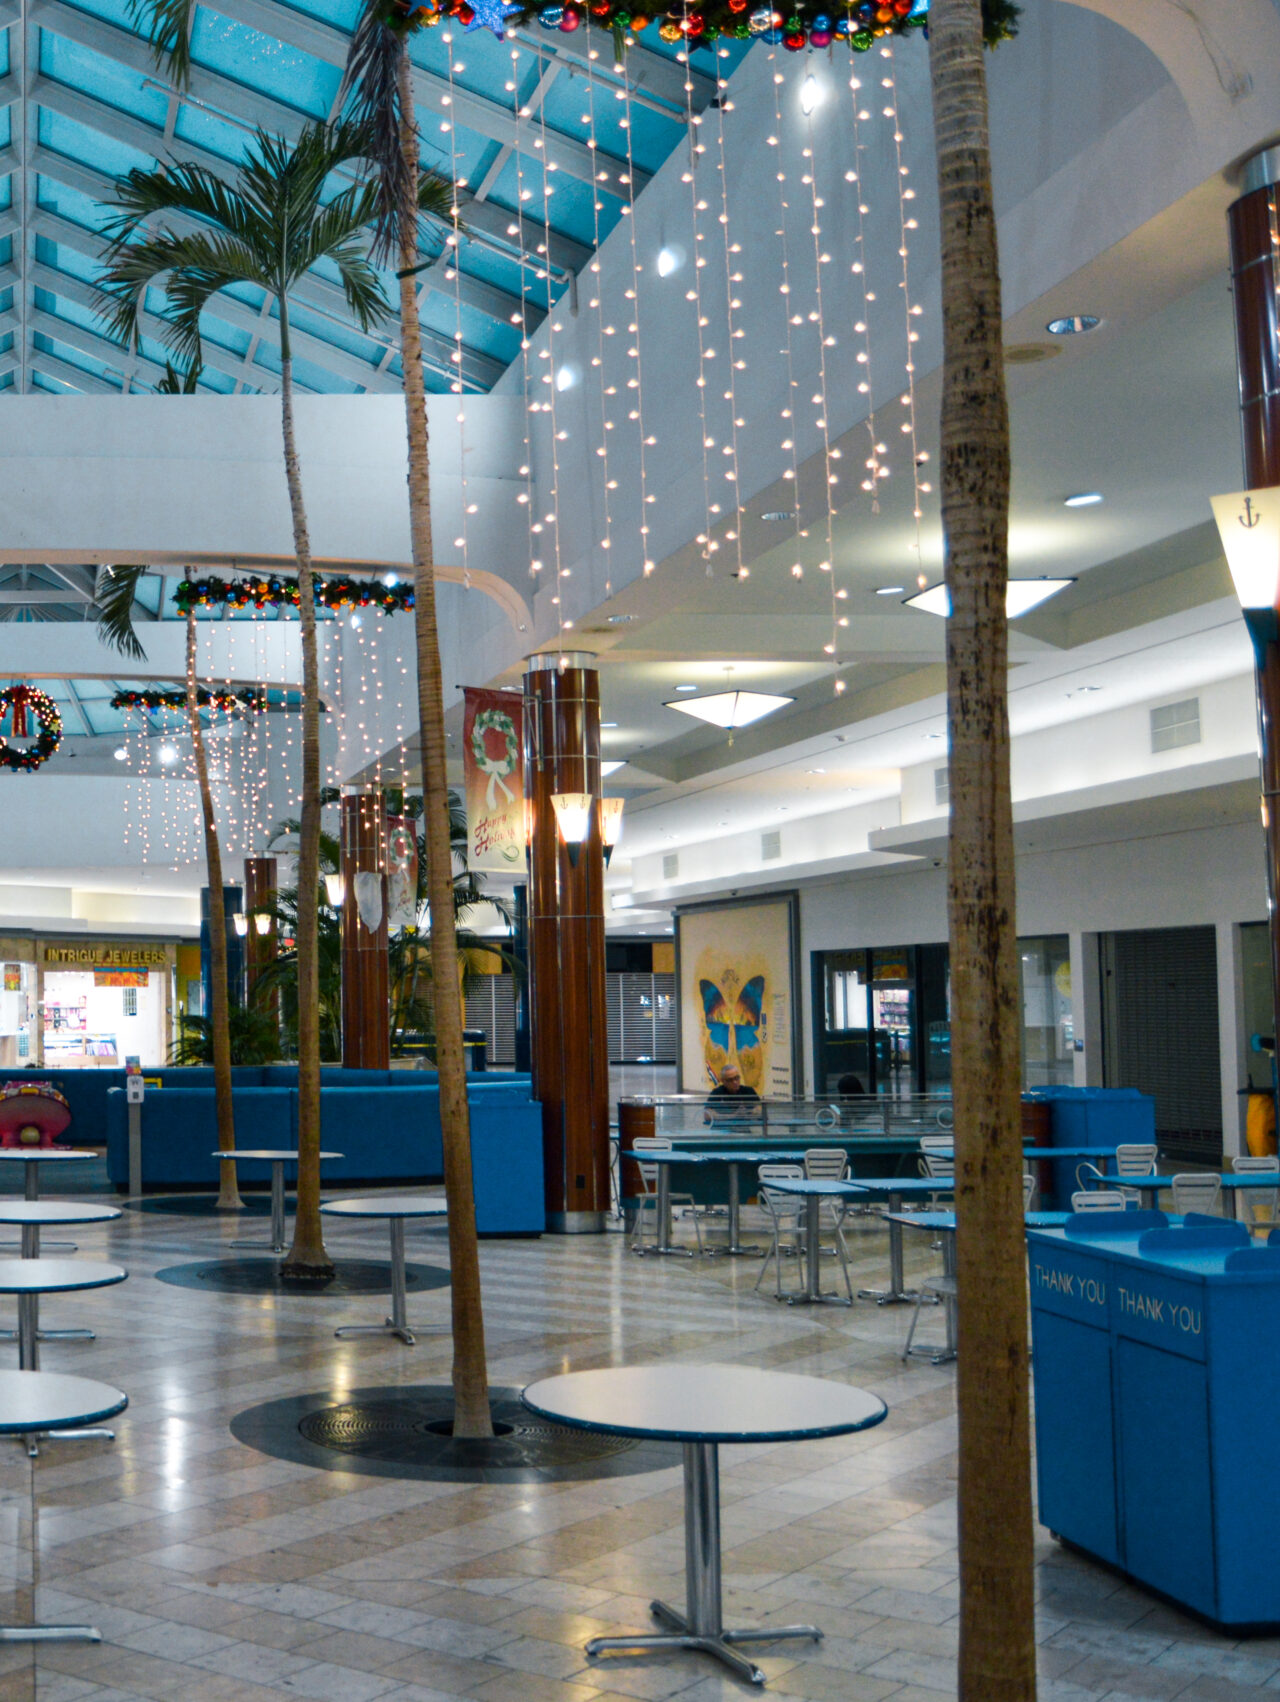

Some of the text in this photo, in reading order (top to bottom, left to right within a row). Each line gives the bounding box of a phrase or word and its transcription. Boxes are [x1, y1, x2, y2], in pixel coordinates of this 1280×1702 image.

[474, 813, 507, 838] Happy
[47, 949, 166, 963] INTRIGUE JEWELERS
[1035, 1264, 1106, 1305] THANK YOU
[1118, 1287, 1202, 1335] THANK YOU
